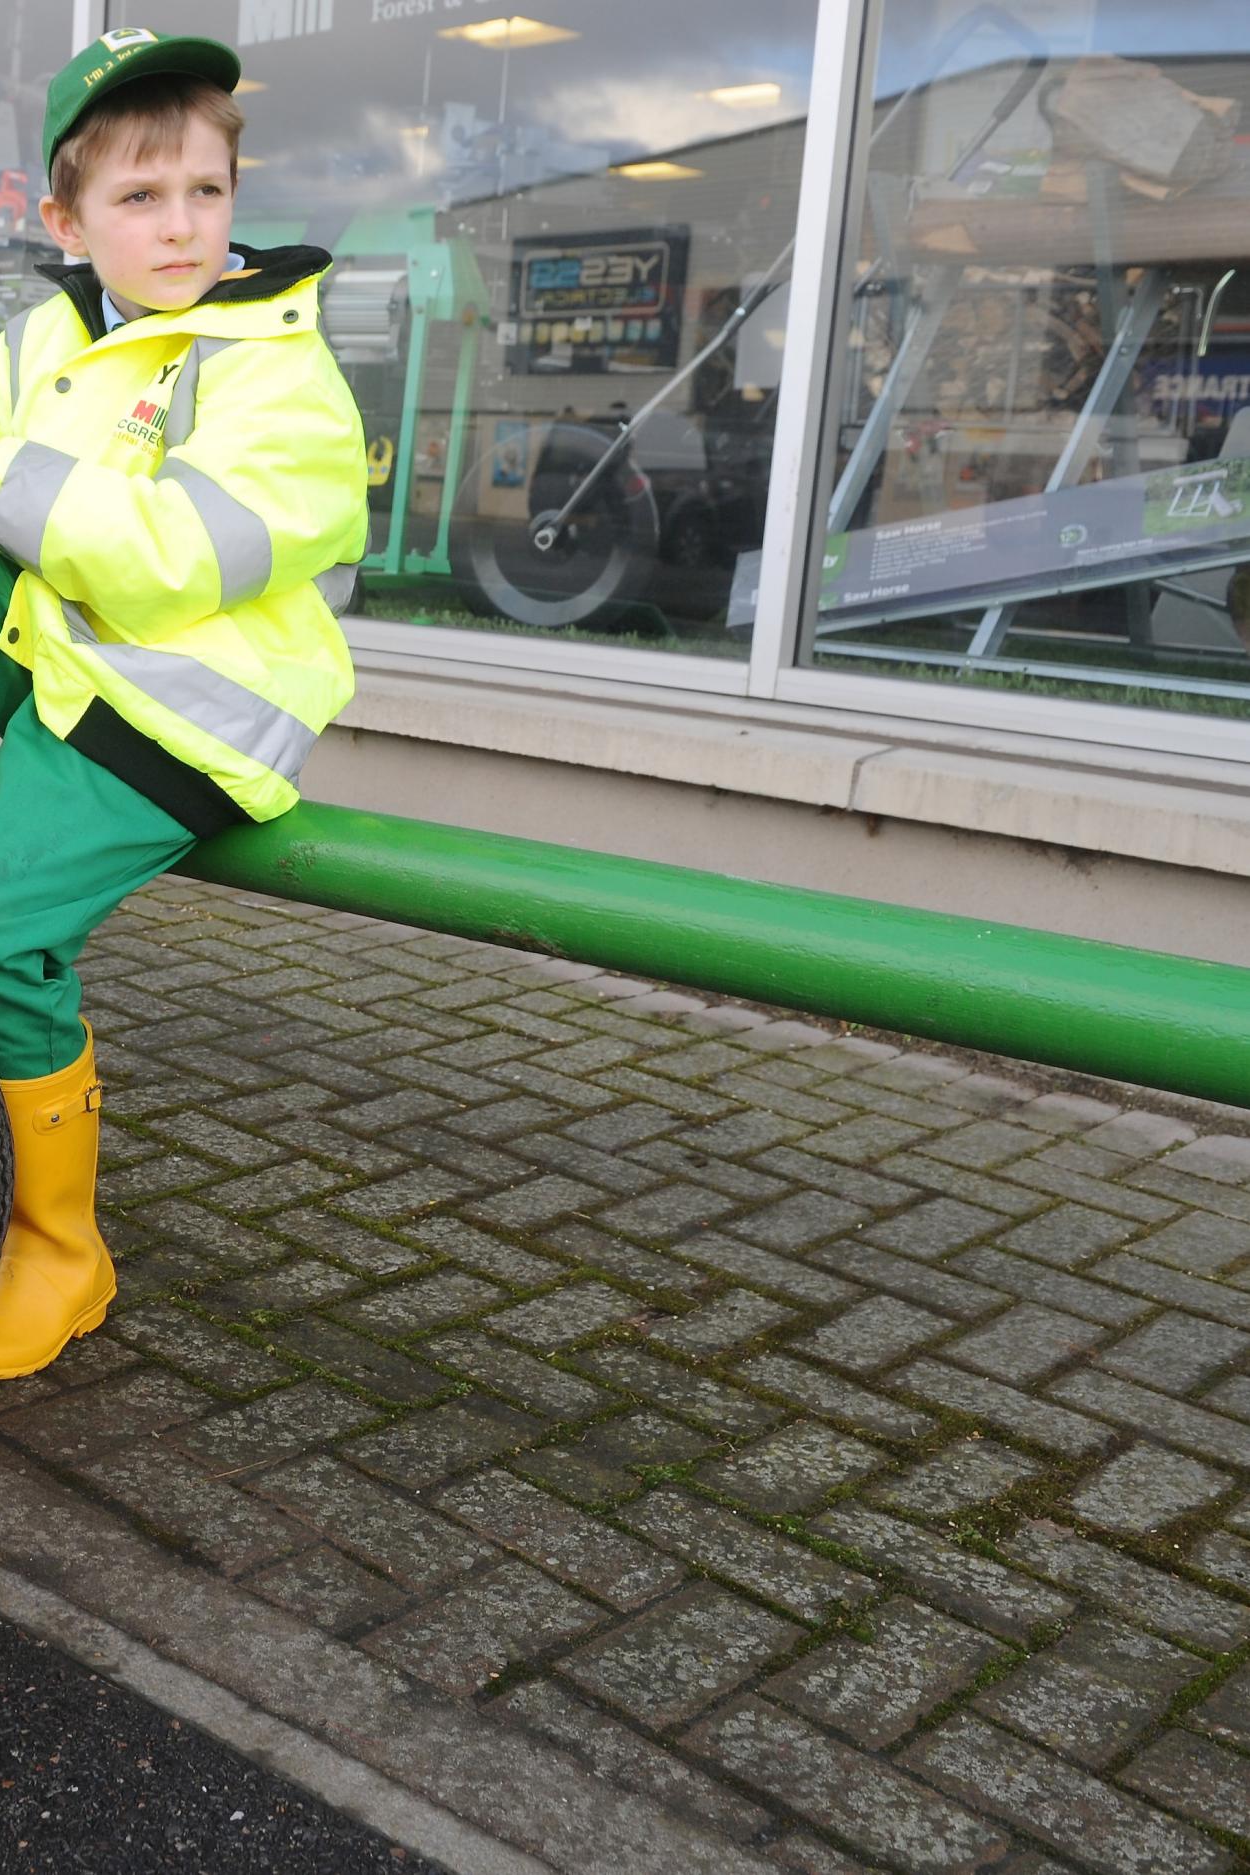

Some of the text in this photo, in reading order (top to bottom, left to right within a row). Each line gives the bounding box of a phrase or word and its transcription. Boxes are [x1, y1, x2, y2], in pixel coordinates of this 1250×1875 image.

[875, 520, 943, 541] Saw Horse
[844, 591, 869, 603] Saw
[872, 583, 910, 599] Horse
